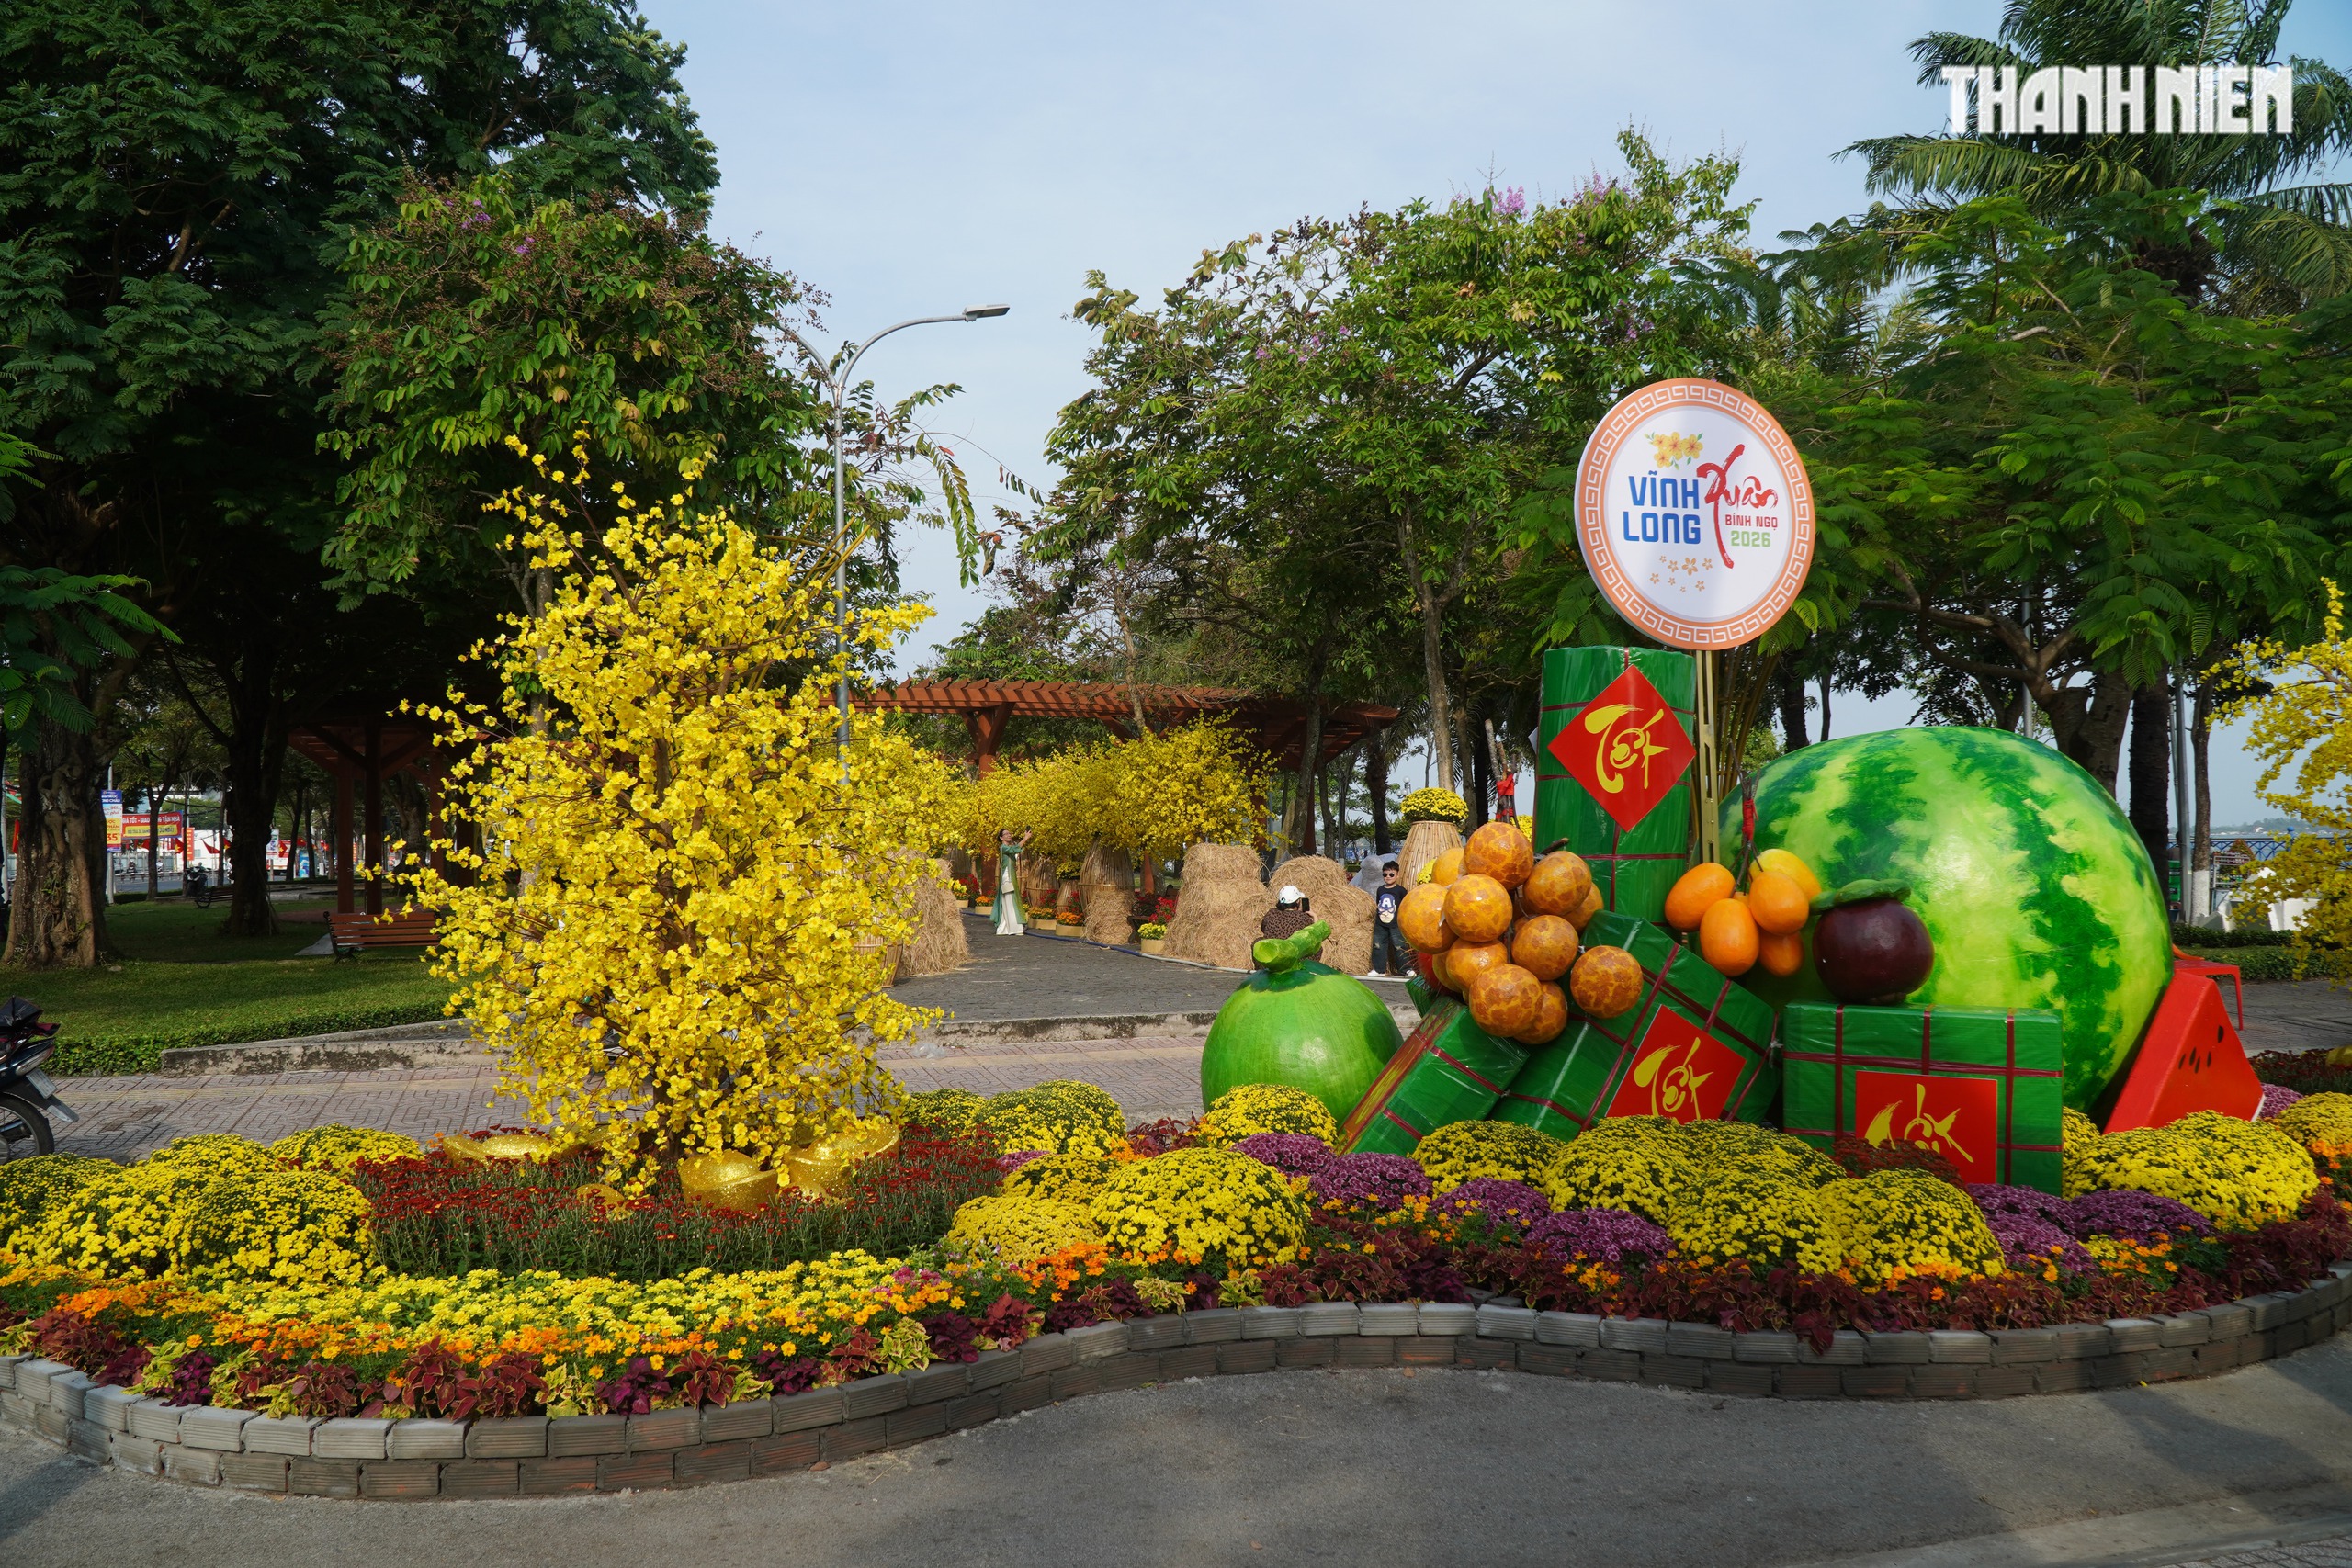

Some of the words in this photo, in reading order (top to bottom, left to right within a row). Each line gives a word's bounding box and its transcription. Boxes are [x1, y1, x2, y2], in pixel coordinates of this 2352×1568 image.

[1628, 470, 1700, 510] VĨNH
[1623, 511, 1702, 545] LONG
[1756, 516, 1778, 531] NGỌ
[1731, 530, 1770, 547] 2026
[1381, 897, 1393, 908] A
